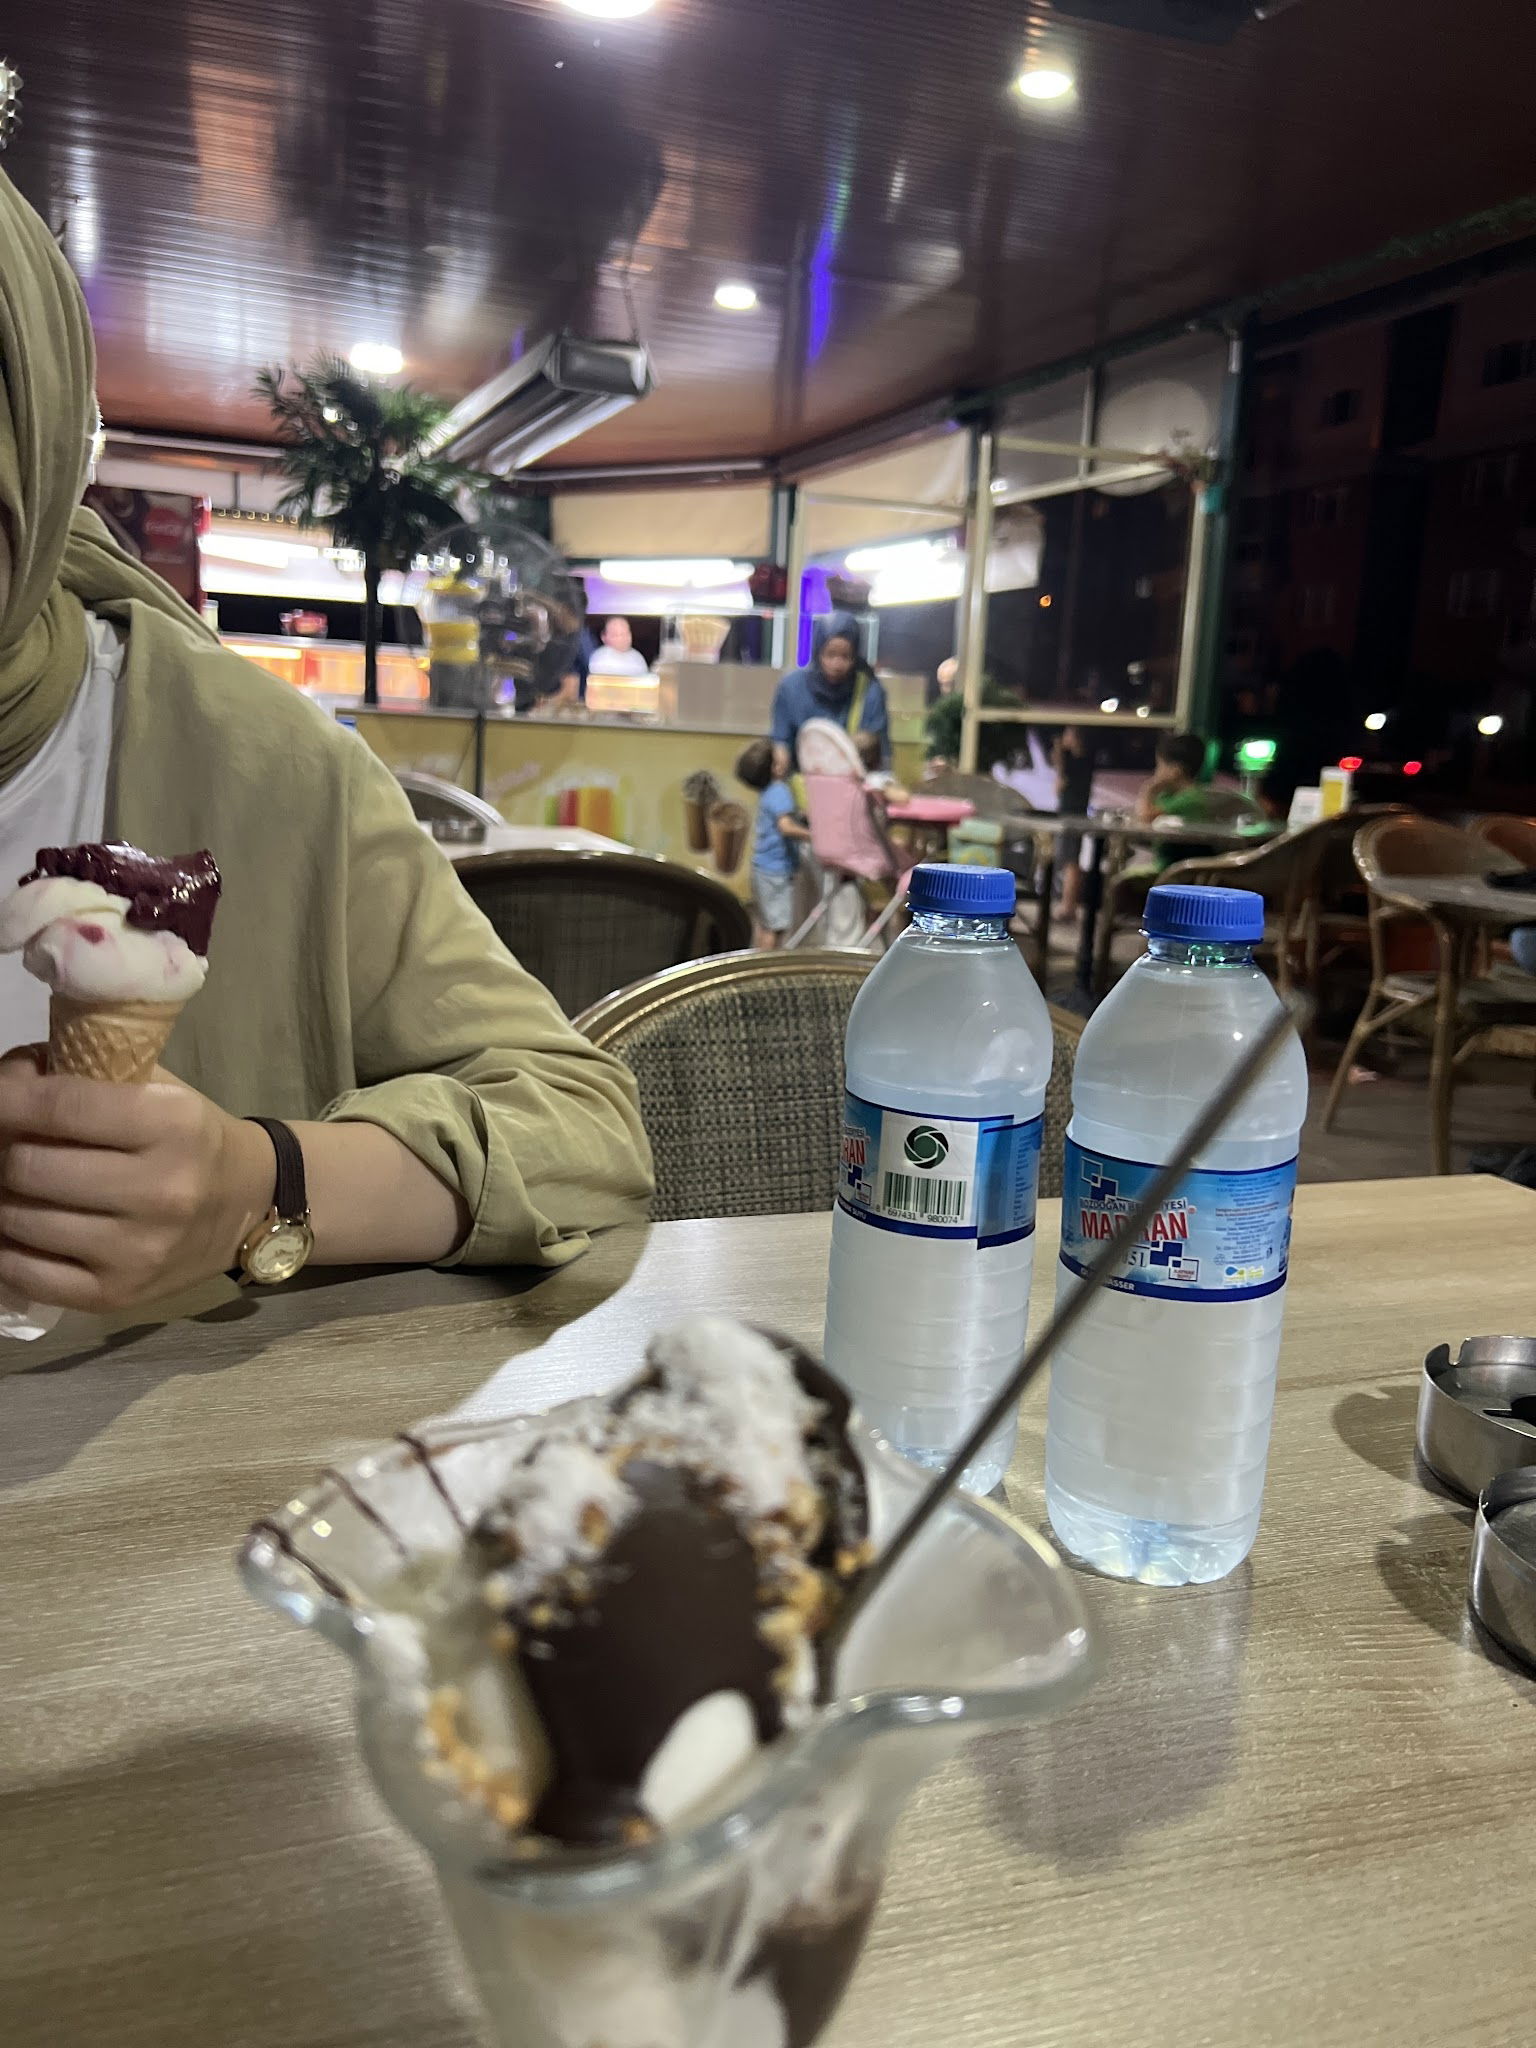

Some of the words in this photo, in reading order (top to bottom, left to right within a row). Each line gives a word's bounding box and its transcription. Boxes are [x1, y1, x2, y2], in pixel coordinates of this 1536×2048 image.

[887, 1208, 917, 1221] 697431
[927, 1214, 958, 1224] 980074
[1081, 1210, 1188, 1241] MADAN
